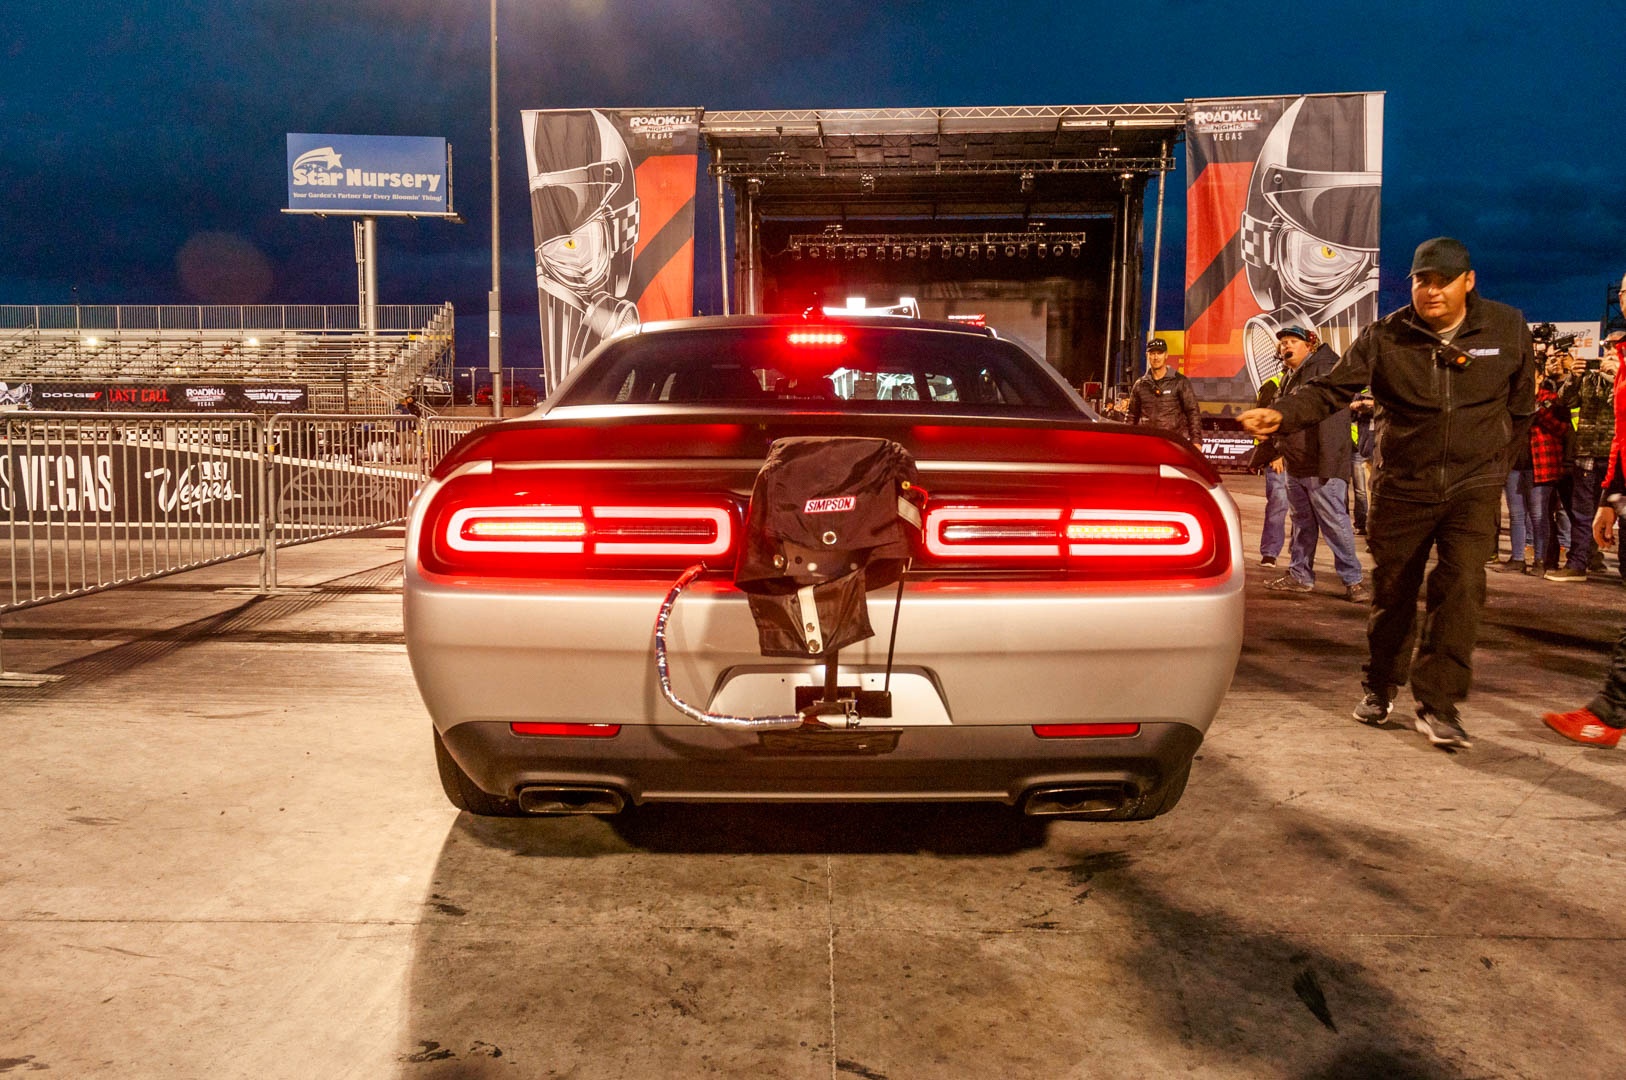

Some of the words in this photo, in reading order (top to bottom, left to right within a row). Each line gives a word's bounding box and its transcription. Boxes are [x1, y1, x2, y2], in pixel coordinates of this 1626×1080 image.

[630, 115, 692, 127] ROADKILL
[1194, 109, 1261, 125] ROADKILL
[1213, 132, 1243, 141] VEGAS
[293, 168, 343, 186] Star
[346, 168, 441, 192] Nursery
[421, 194, 443, 202] Thing!
[109, 389, 138, 402] LAST
[141, 389, 170, 402] CALL
[186, 388, 226, 397] ROADKILL
[19, 455, 116, 512] VEGAS
[144, 464, 242, 515] Vegas
[807, 498, 852, 511] SIMPSON
